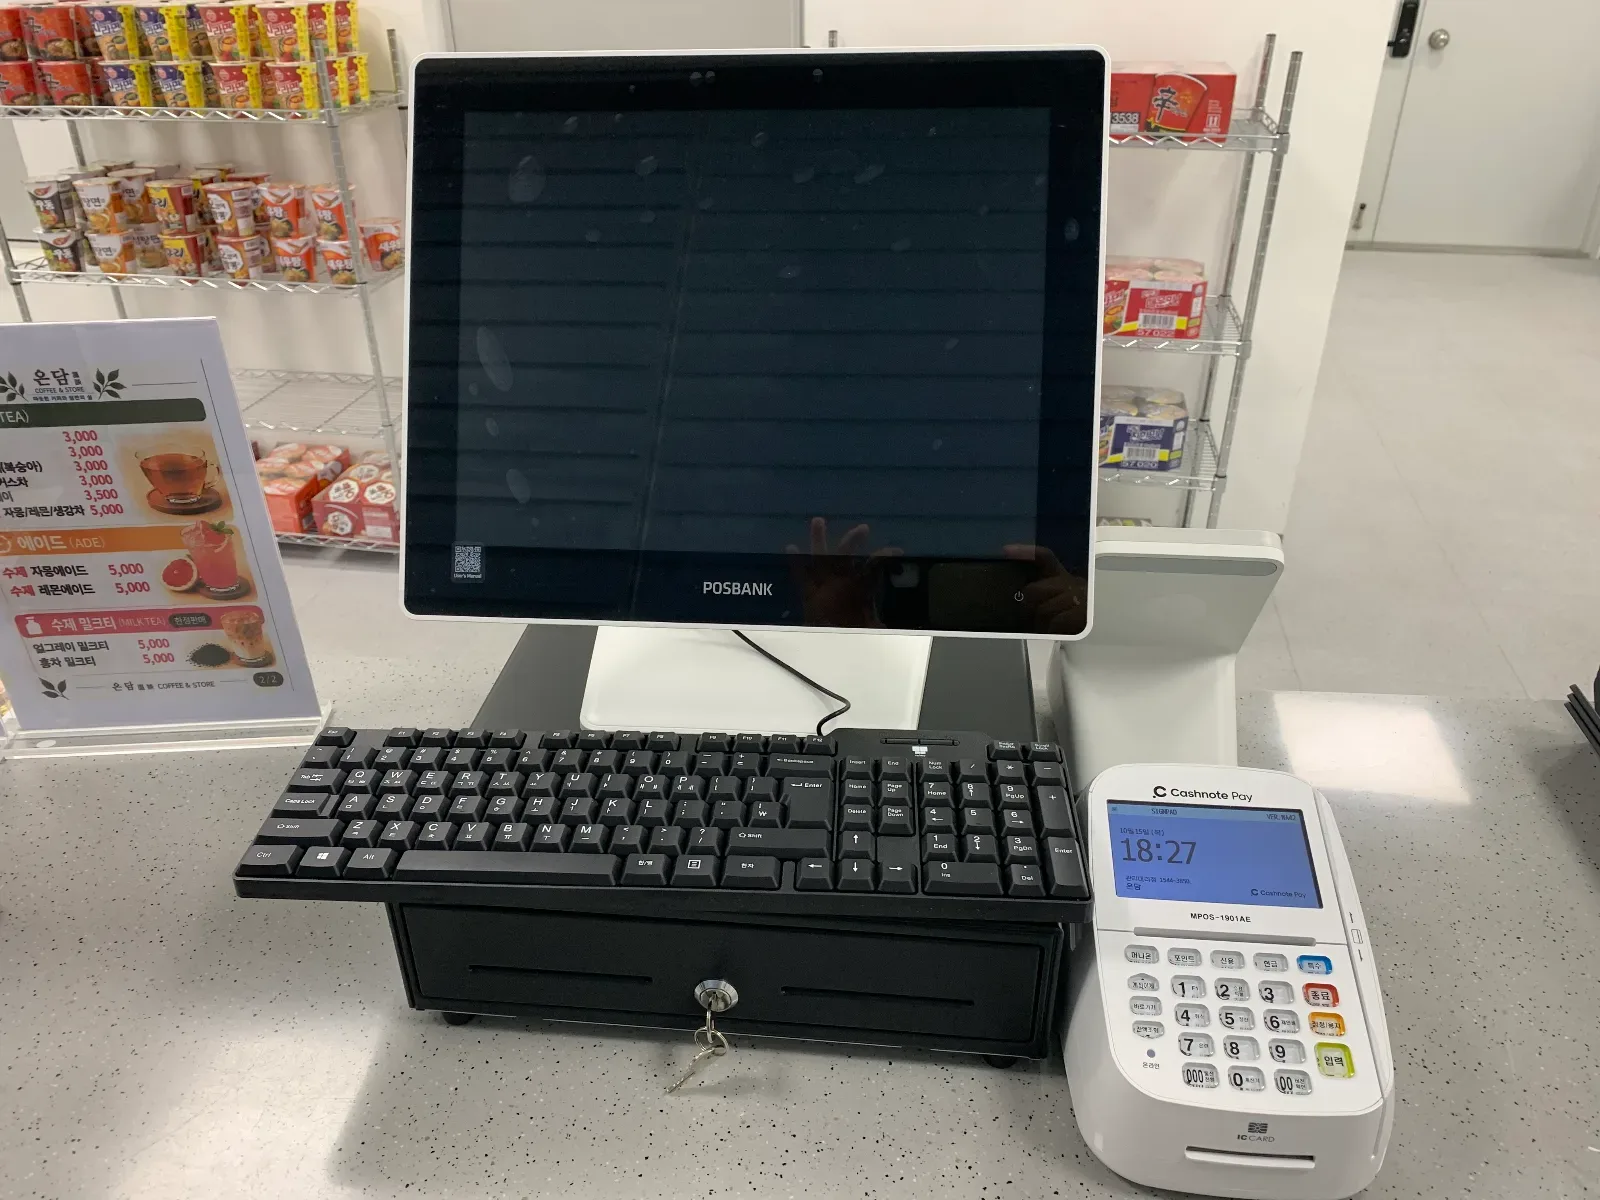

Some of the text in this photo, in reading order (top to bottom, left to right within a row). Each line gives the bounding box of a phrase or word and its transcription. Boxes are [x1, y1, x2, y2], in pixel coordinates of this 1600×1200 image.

[62, 430, 98, 444] 3,000
[68, 445, 103, 459] 3,000
[0, 460, 108, 473] (복숭아) 3,000
[79, 474, 113, 488] 3,000
[84, 489, 118, 502] 3,500
[90, 504, 124, 517] 5,000
[17, 535, 105, 550] 에이드 (ADE)
[2, 563, 144, 579] 수제 자몽에이드 5,000
[10, 581, 150, 597] 수제 레몬에이드 5,000
[703, 581, 773, 596] POSBANK
[51, 617, 77, 631] 수제
[79, 616, 117, 631] 밀크티
[33, 638, 169, 654] 얼그레이 밀크티 5,000
[38, 653, 175, 669] 홍차 밀크티 5,000
[1171, 788, 1253, 802] Cashnote Pay
[391, 822, 402, 830] X
[1120, 837, 1197, 865] 18:27
[1260, 889, 1293, 898] Cashnote
[1293, 891, 1307, 899] Pay
[1190, 912, 1251, 923] MPOS-1901AE
[1178, 981, 1186, 995] 1
[1220, 984, 1231, 998] 2
[1264, 987, 1275, 1000] 3
[1311, 990, 1331, 1001] 종료
[1181, 1009, 1190, 1022] 4
[1225, 1012, 1235, 1025] 5
[1269, 1015, 1280, 1029] 6
[1183, 1038, 1194, 1051] 7
[1229, 1042, 1240, 1056] 8
[1275, 1045, 1286, 1058] 9
[1324, 1056, 1344, 1067] 입력
[1186, 1068, 1204, 1083] 000
[1233, 1072, 1243, 1087] 0
[1280, 1076, 1293, 1091] 00
